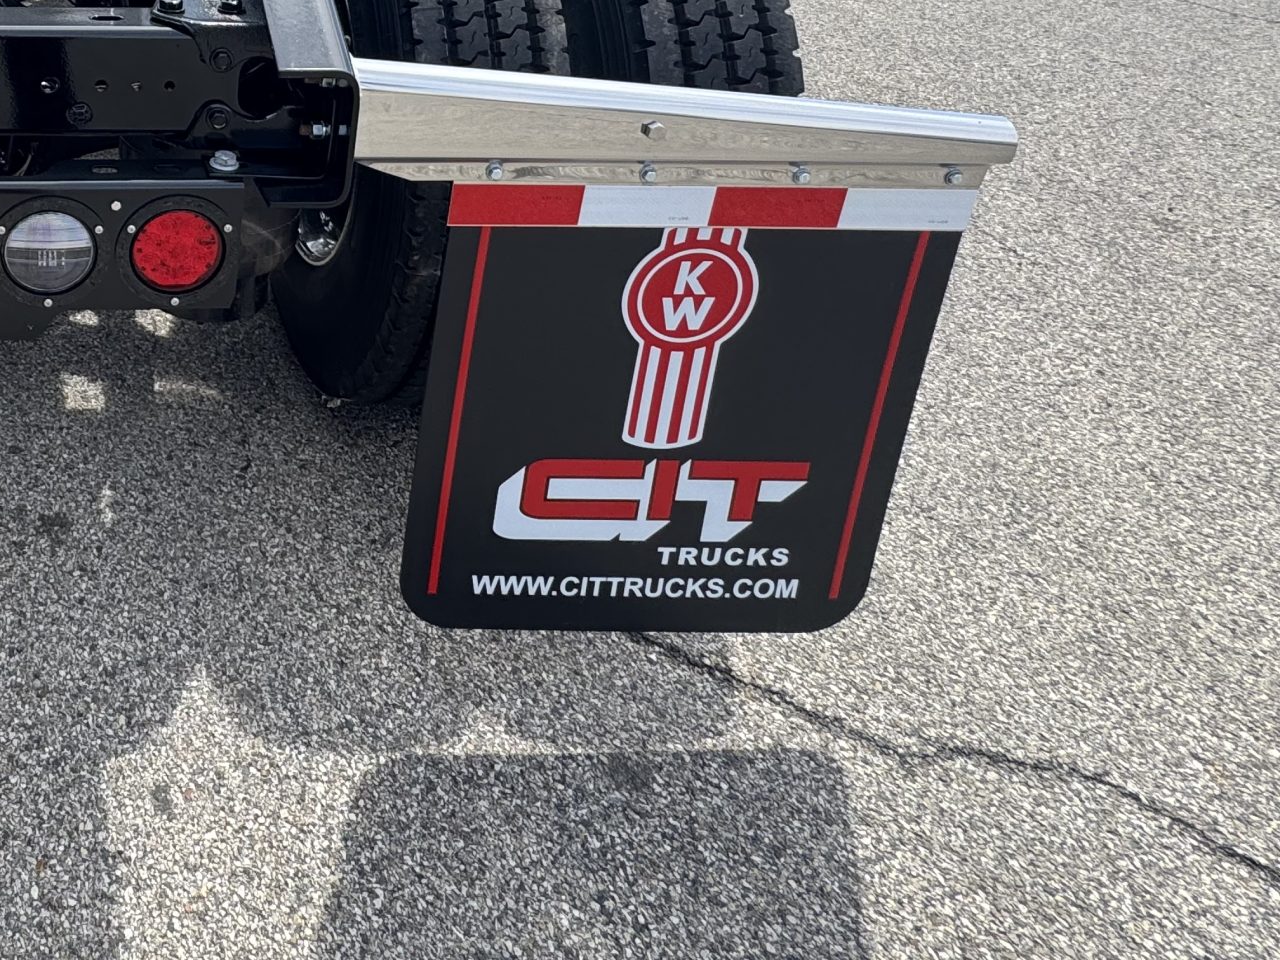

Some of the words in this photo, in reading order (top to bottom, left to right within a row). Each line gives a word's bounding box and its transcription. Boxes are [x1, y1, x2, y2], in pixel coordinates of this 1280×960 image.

[492, 458, 810, 542] CIT
[657, 546, 790, 567] TRUCKS
[471, 575, 799, 599] WWW.CITTRUCKS.COM
